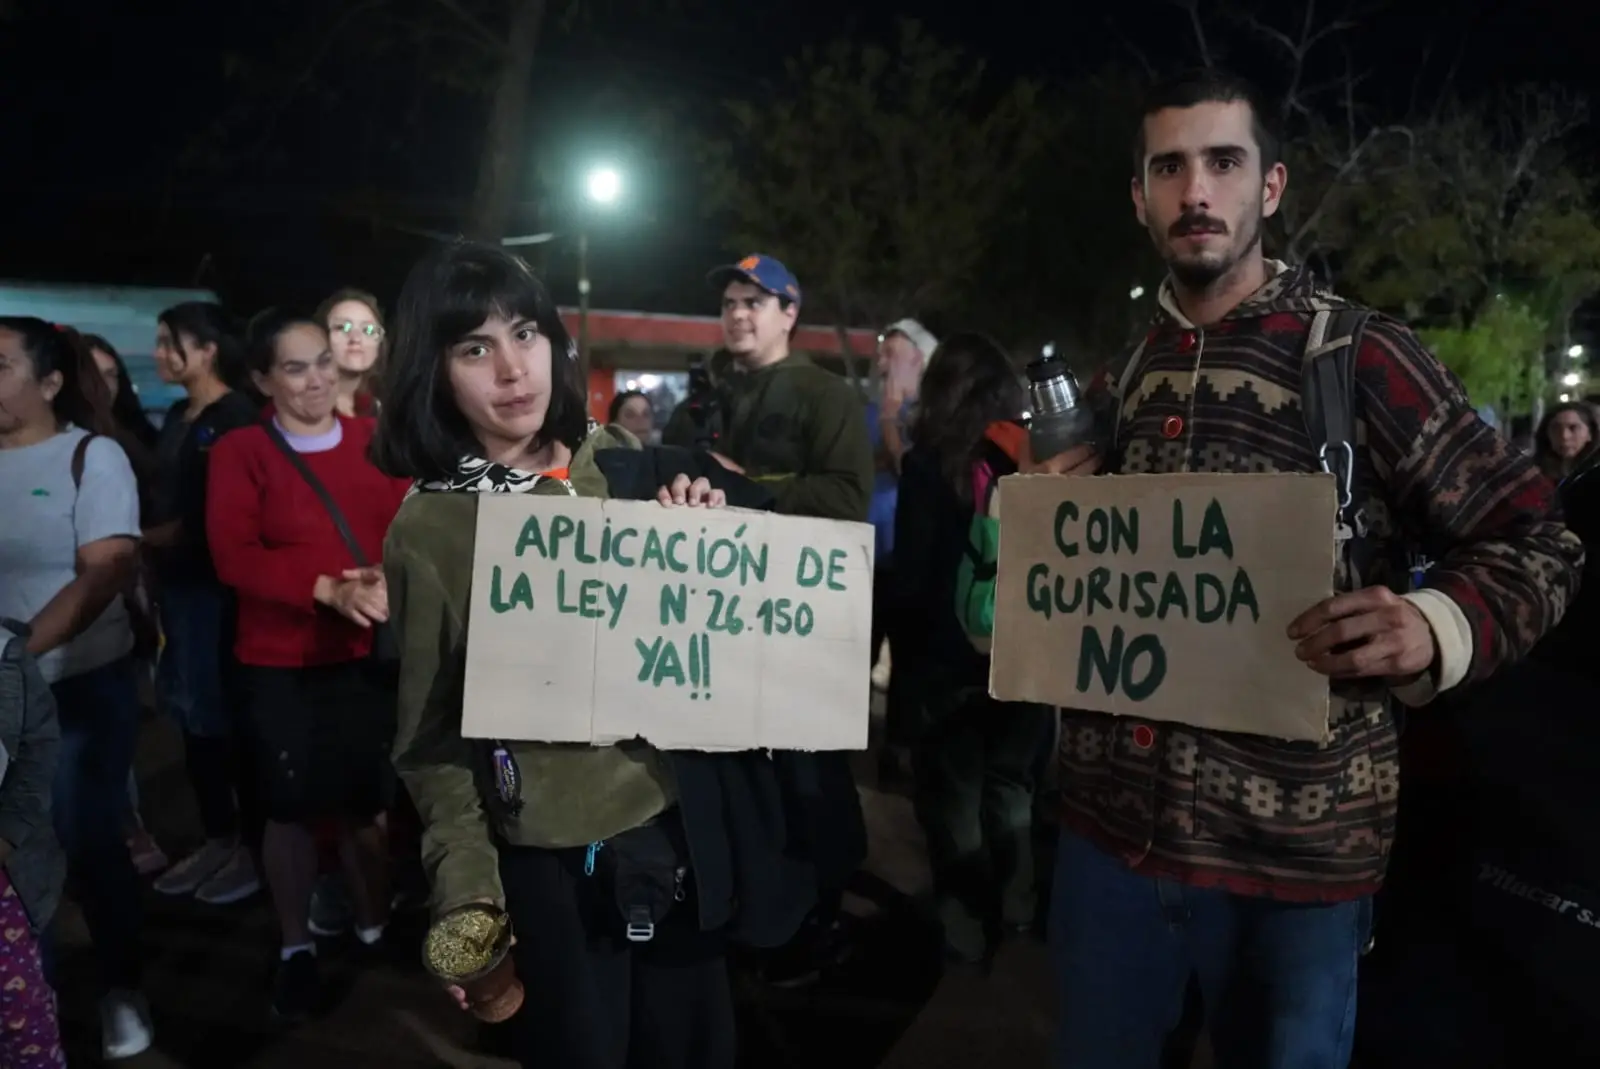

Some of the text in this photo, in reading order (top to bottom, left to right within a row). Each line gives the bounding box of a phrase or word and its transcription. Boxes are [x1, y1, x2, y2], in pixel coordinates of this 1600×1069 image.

[1053, 497, 1234, 560] CON LA
[489, 565, 534, 614] LA
[556, 568, 629, 630] LEY
[706, 588, 815, 637] 26.150
[796, 546, 848, 592] DE
[1026, 562, 1261, 624] GURISADA
[634, 632, 712, 701] YA!!
[1075, 624, 1168, 702] NO
